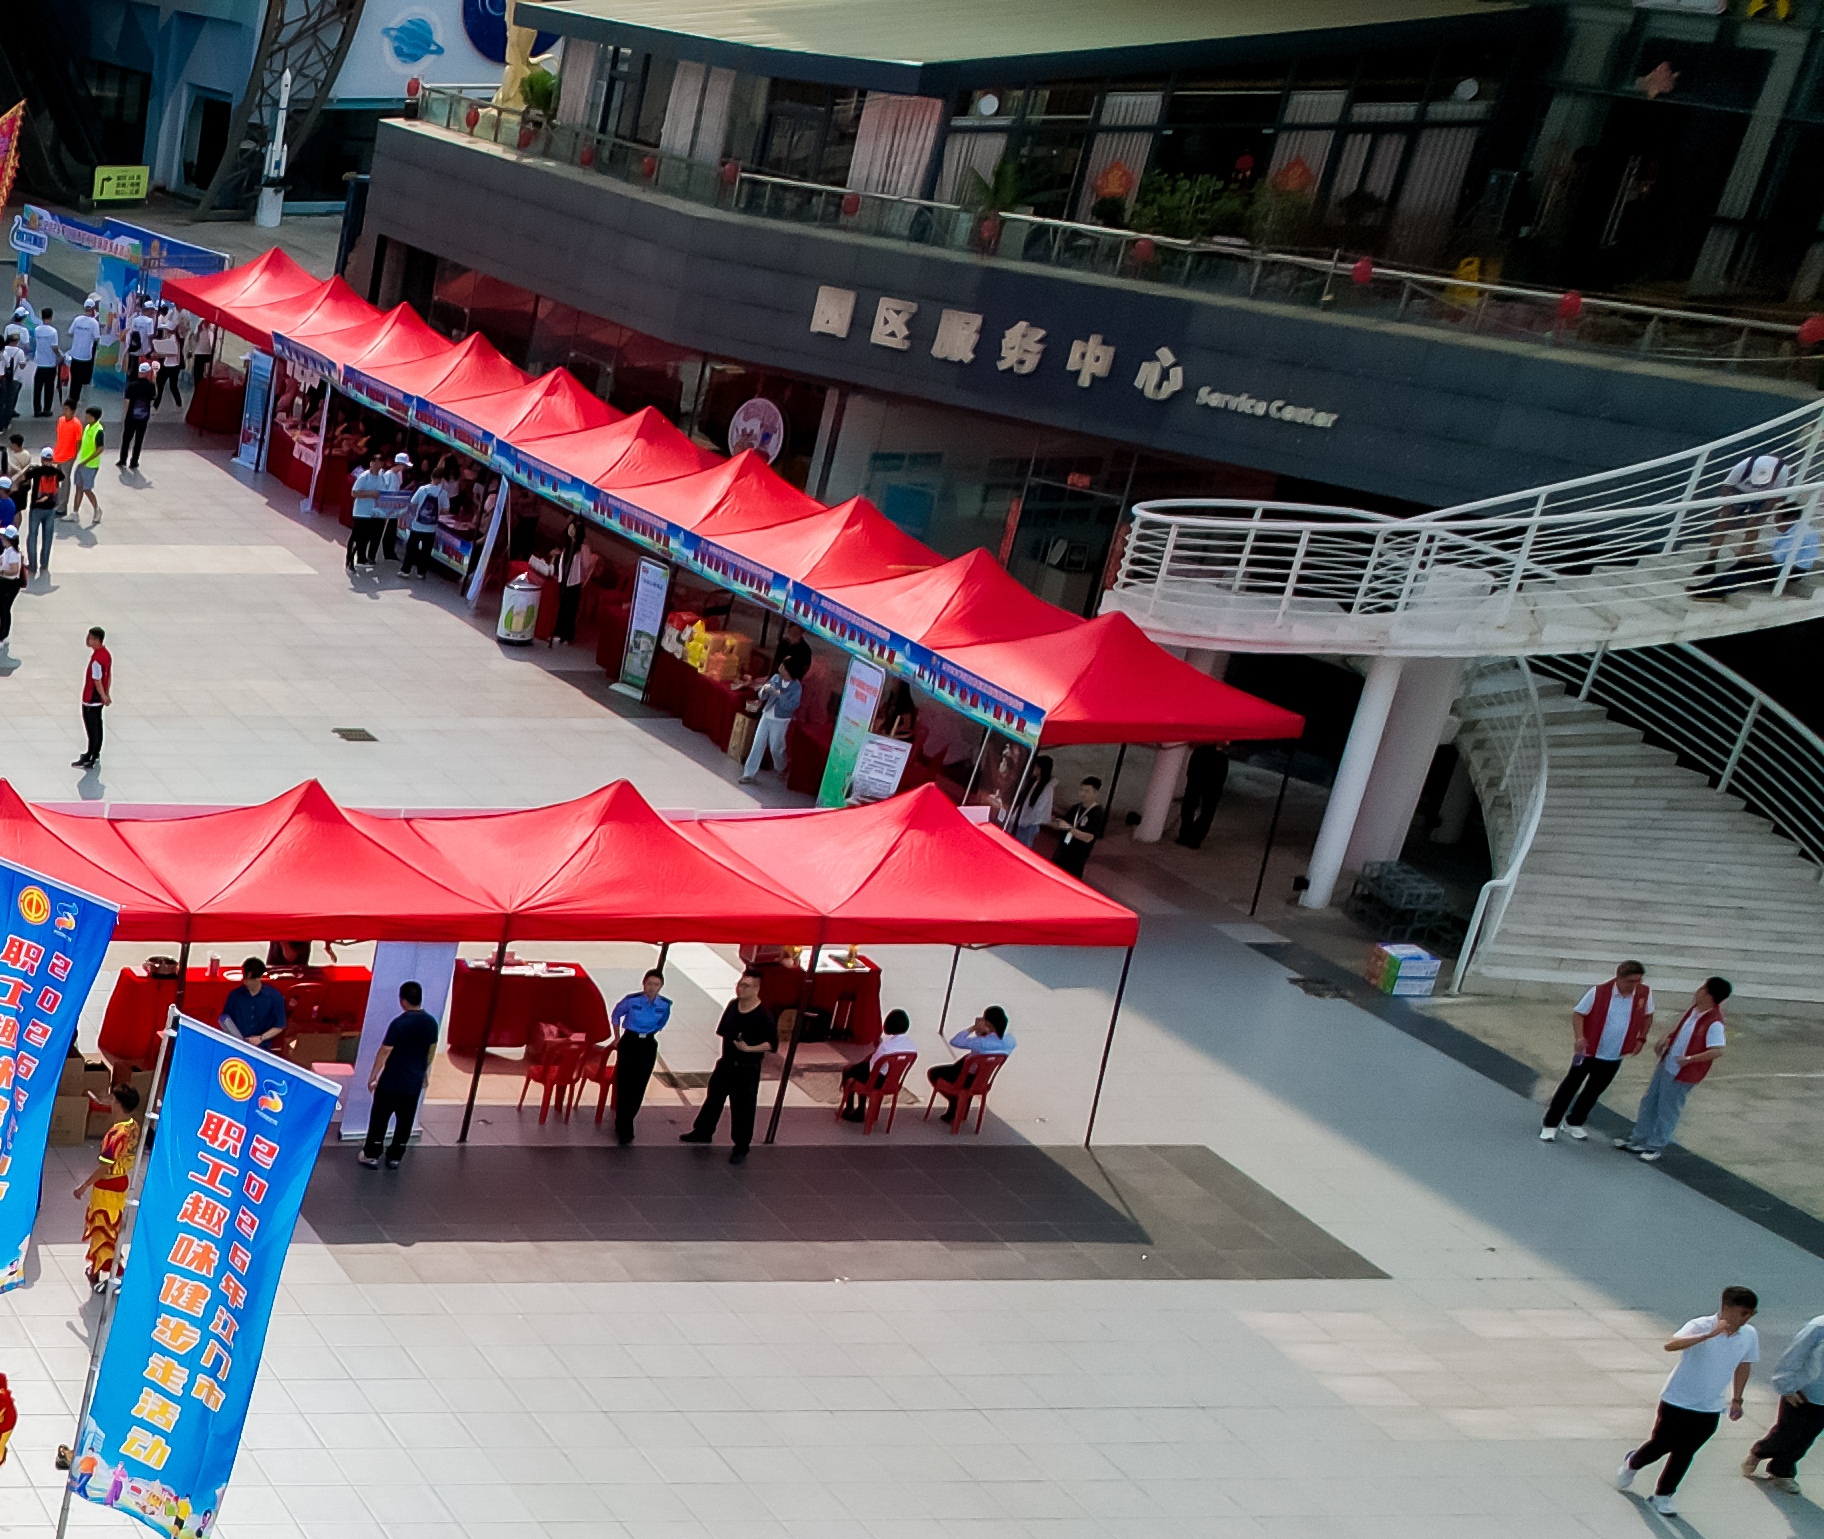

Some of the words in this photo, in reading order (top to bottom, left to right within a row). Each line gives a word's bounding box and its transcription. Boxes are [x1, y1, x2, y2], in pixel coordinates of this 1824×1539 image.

[810, 285, 1184, 400] 园区服务中心
[1196, 386, 1268, 417] Service
[1268, 400, 1339, 427] Center
[118, 1109, 248, 1471] 职工趣味健步走活动
[191, 1132, 280, 1413] 2026年江门市
